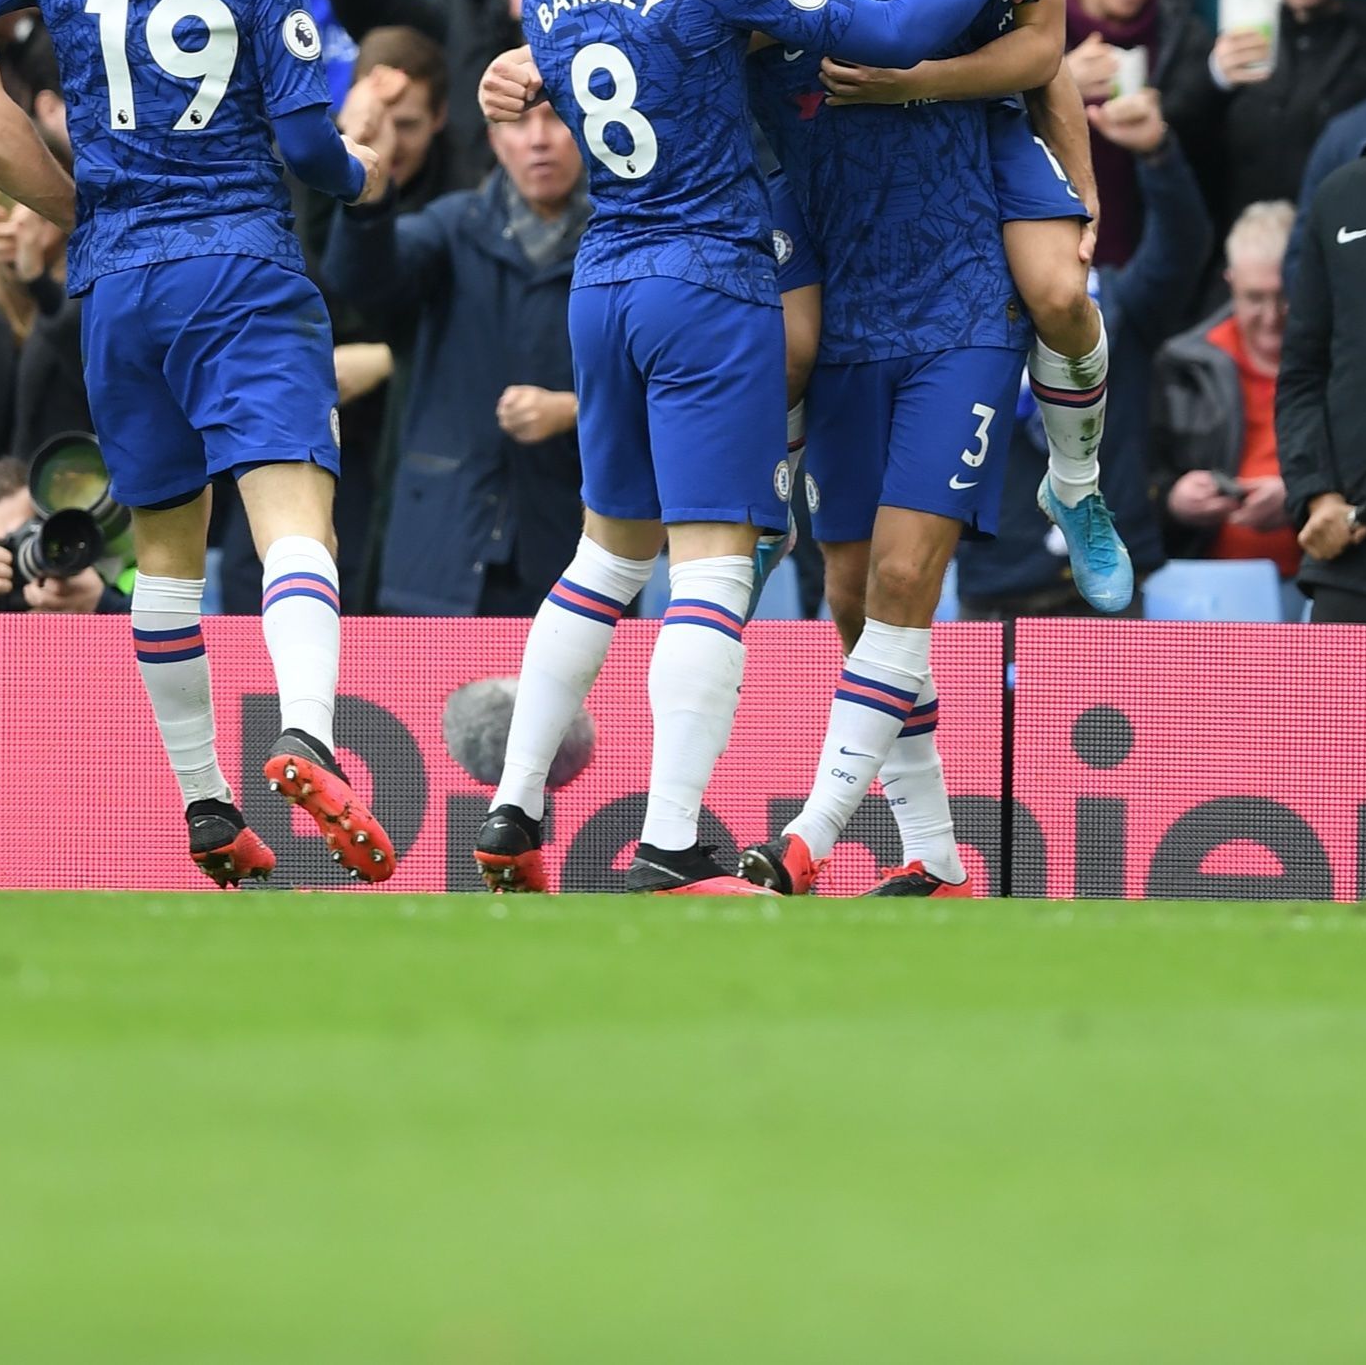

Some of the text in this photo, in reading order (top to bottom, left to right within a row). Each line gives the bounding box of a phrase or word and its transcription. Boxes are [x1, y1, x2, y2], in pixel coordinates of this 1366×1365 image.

[570, 42, 658, 180] 8
[960, 402, 996, 468] 3
[830, 767, 858, 785] CFC
[887, 796, 908, 807] FC
